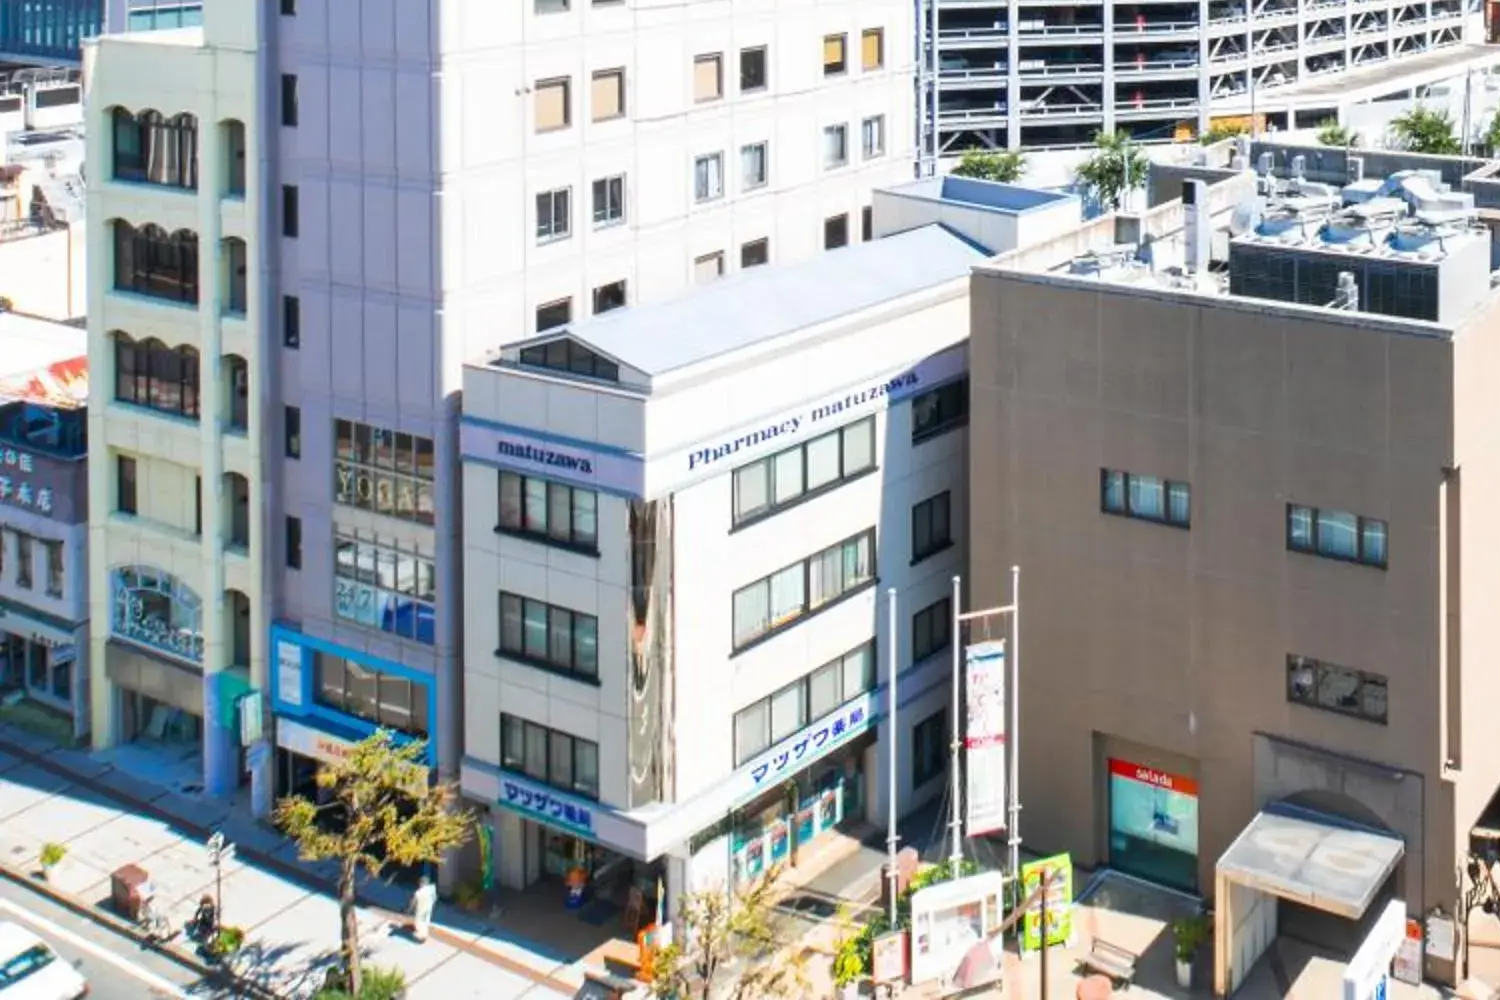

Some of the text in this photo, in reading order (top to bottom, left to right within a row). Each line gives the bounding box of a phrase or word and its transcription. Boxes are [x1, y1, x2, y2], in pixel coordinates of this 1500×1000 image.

[688, 371, 919, 471] Pharmacy matuzawa
[497, 440, 593, 474] matuzawa
